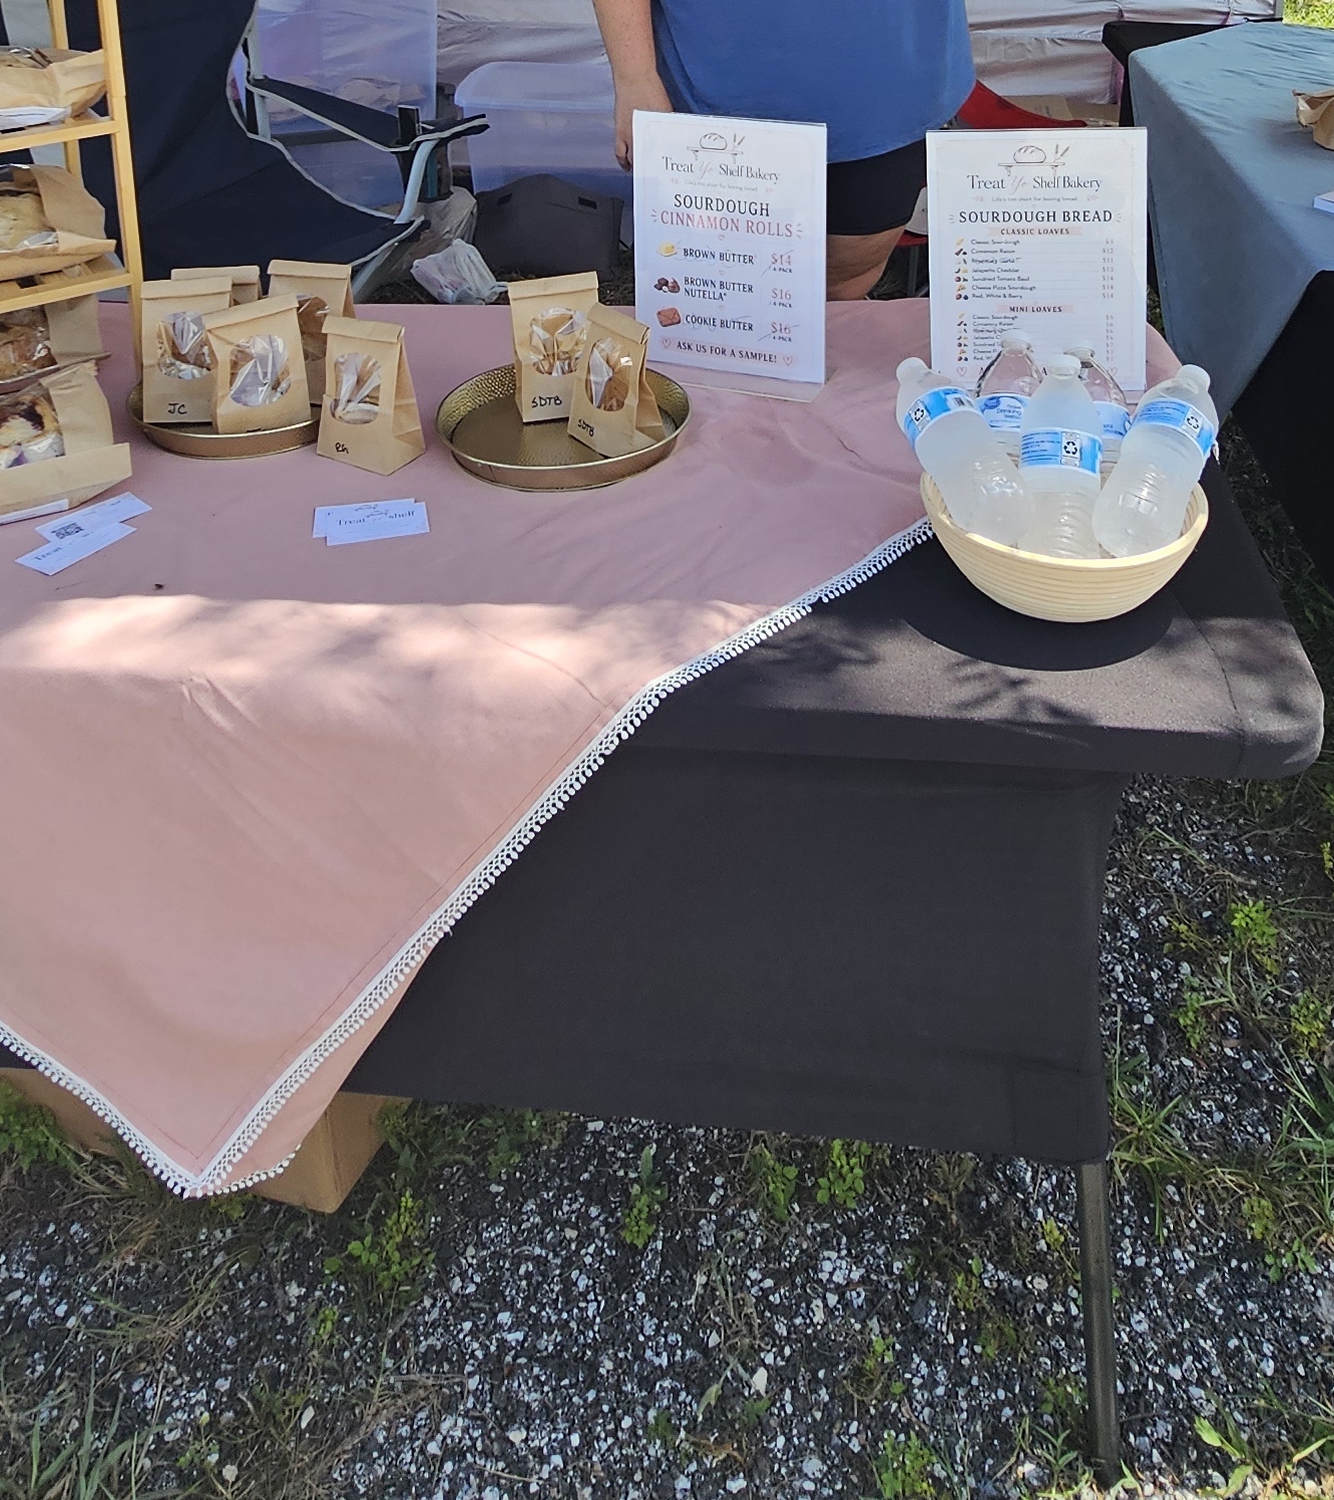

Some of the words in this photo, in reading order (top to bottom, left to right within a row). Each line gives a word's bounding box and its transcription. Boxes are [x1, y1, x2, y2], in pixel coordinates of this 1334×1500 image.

[662, 156, 694, 173] Treat
[719, 163, 744, 177] Shelf
[746, 167, 780, 184] Bakery
[967, 174, 1005, 190] Treat
[1032, 176, 1061, 189] Shelf
[1063, 176, 1103, 192] Bakery
[674, 194, 770, 217] SOURDOUGH
[660, 210, 740, 232] CINNAMON
[746, 219, 793, 237] ROLLS
[959, 211, 1056, 223] SOURDOUGH
[1062, 210, 1113, 222] BREAD
[683, 248, 716, 260] BROWN
[771, 253, 792, 265] $14
[684, 276, 717, 289] BROWN
[719, 280, 754, 293] BUTTER
[771, 288, 792, 300] $16
[685, 314, 717, 327] COOKIE
[720, 318, 754, 331] BUTTER
[771, 322, 792, 334] $16
[676, 341, 693, 351] ASK
[696, 344, 707, 353] US
[710, 345, 727, 356] FOR
[731, 348, 737, 357] A
[739, 350, 777, 363] SAMPLE!
[168, 403, 188, 415] JC
